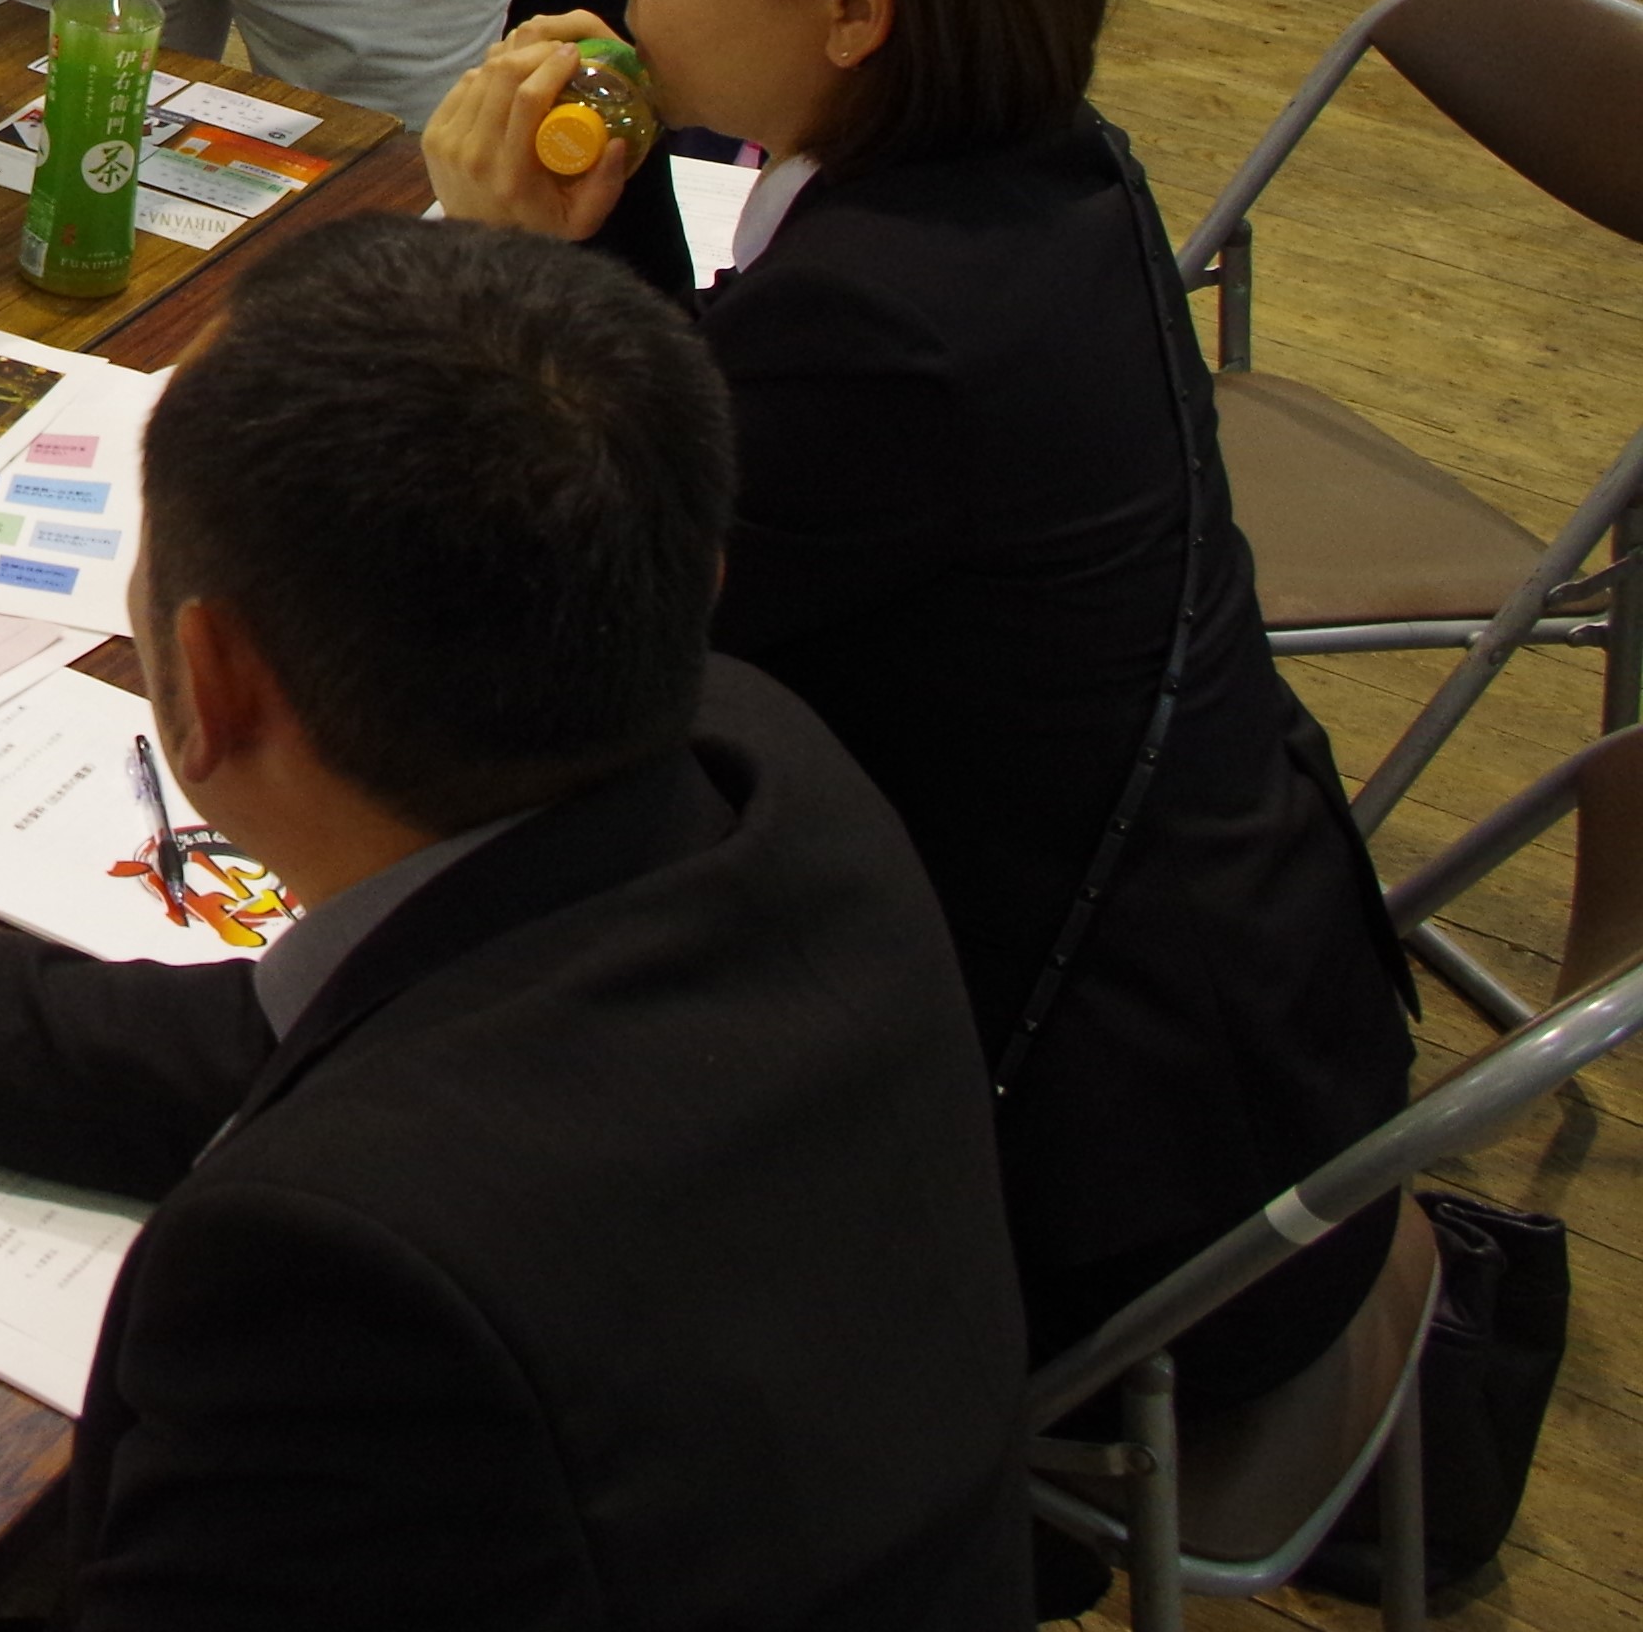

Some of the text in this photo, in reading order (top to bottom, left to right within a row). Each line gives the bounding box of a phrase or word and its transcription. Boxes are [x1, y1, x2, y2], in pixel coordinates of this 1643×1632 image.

[106, 49, 139, 136] 伊右衛門
[88, 145, 129, 186] 茶
